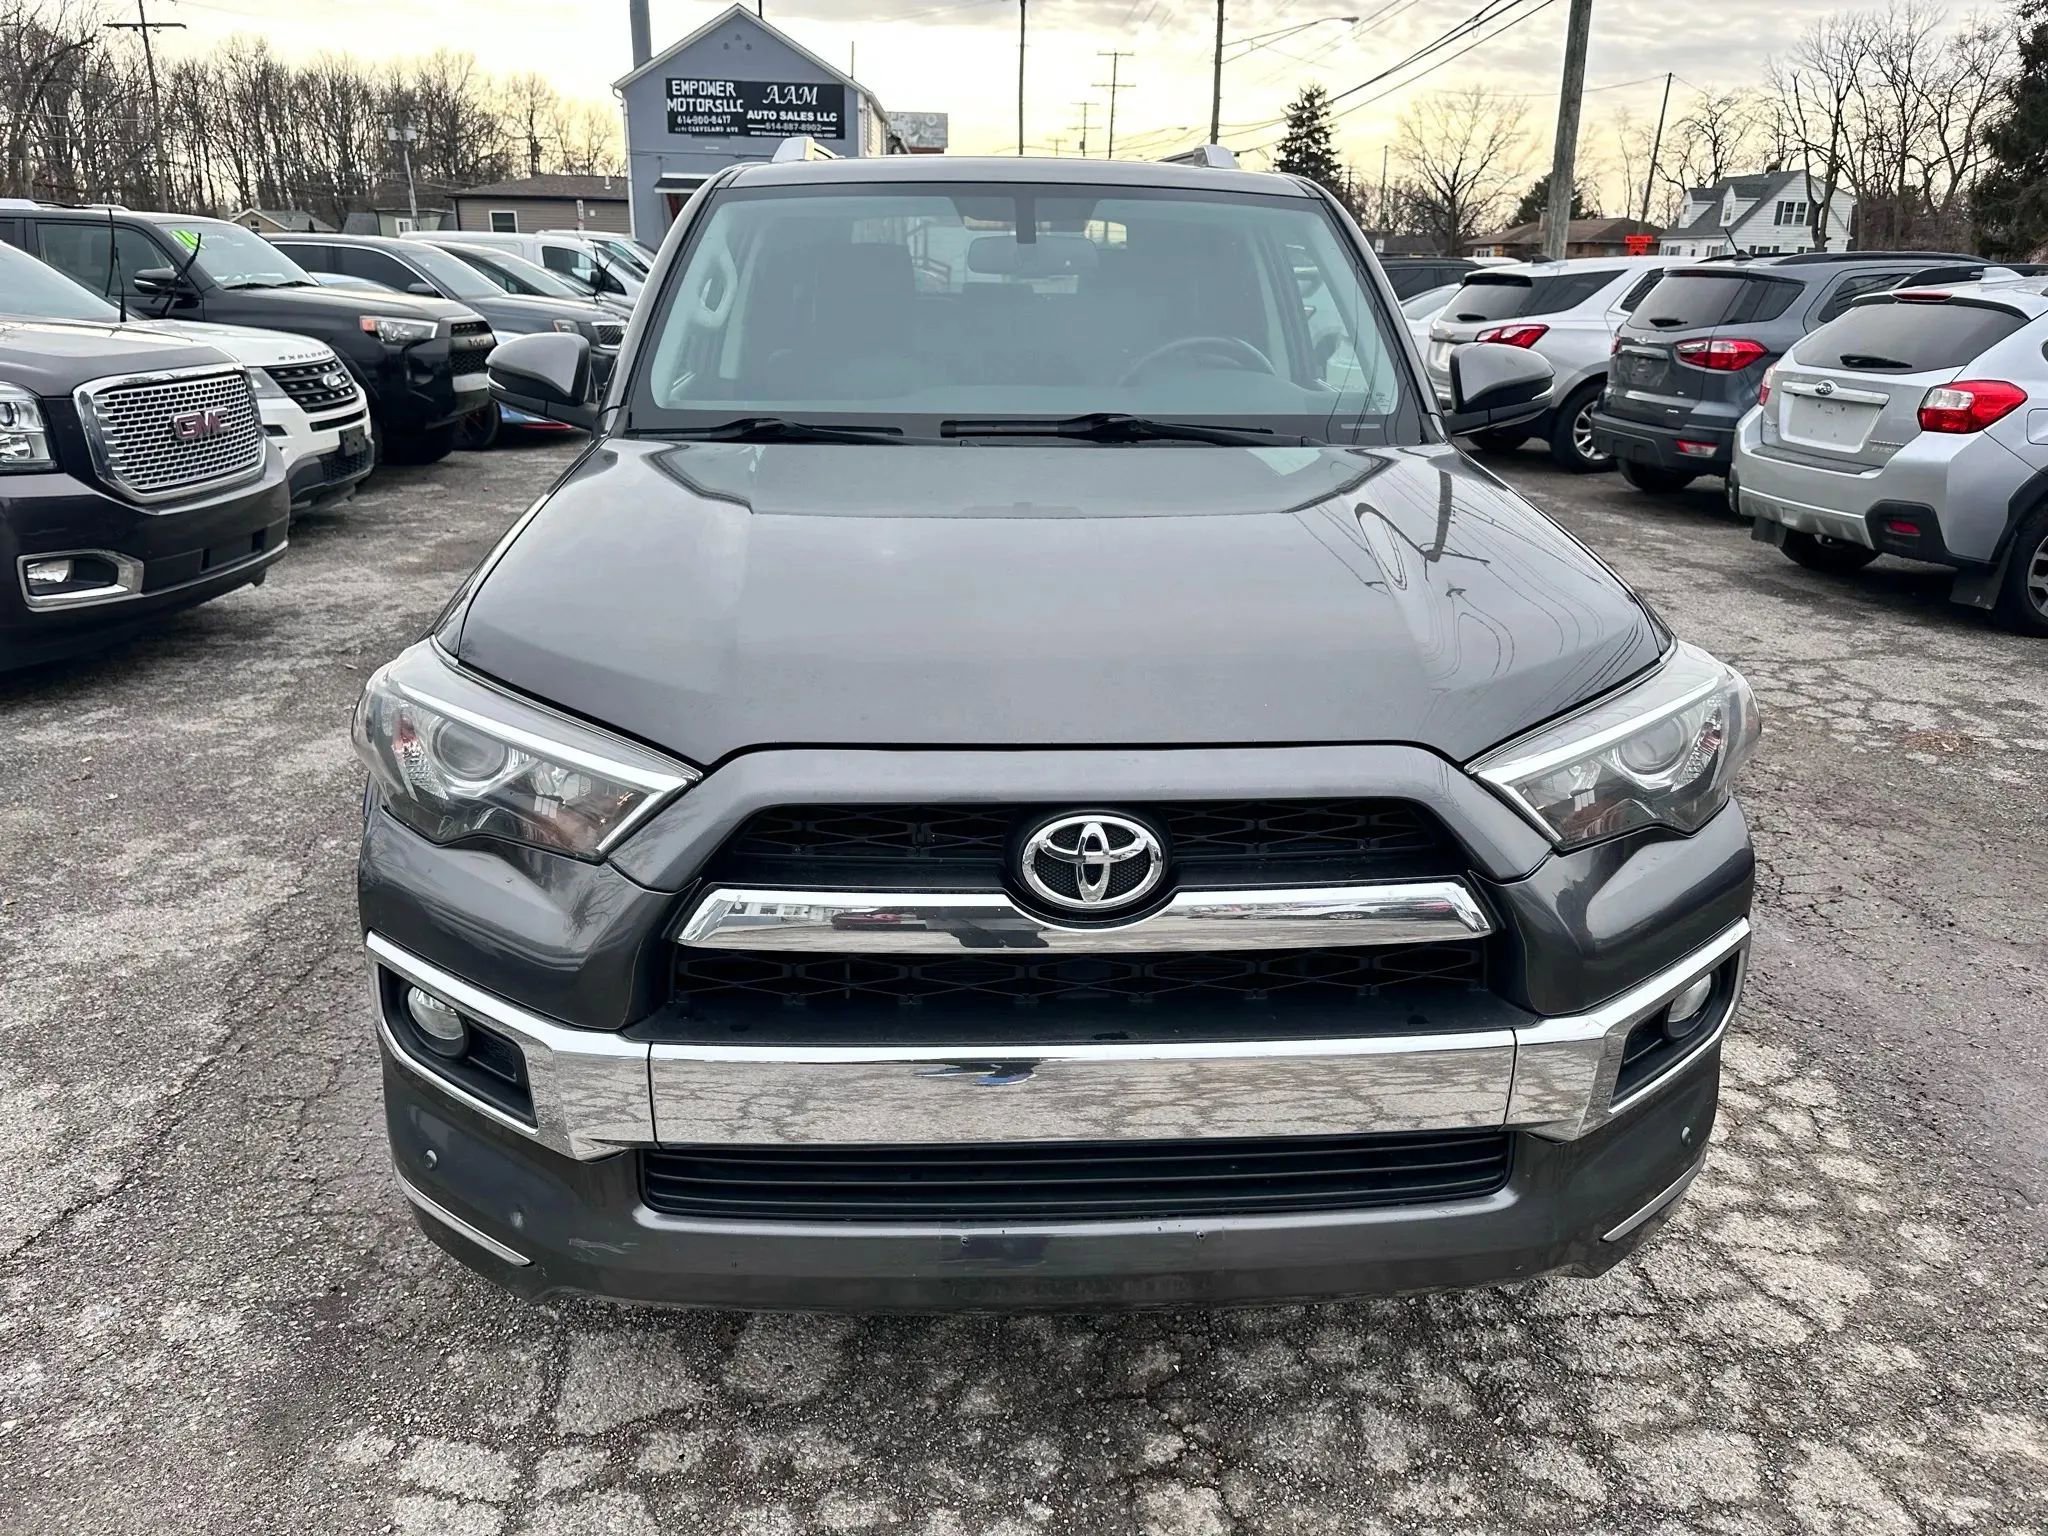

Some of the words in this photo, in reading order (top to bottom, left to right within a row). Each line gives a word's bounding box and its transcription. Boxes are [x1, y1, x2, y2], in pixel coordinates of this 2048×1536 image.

[672, 80, 736, 97] EMPOWER
[762, 84, 818, 105] AAM
[746, 109, 777, 120] AUTO
[779, 110, 815, 122] SALES
[816, 112, 838, 123] LLC
[173, 407, 231, 440] GMC
